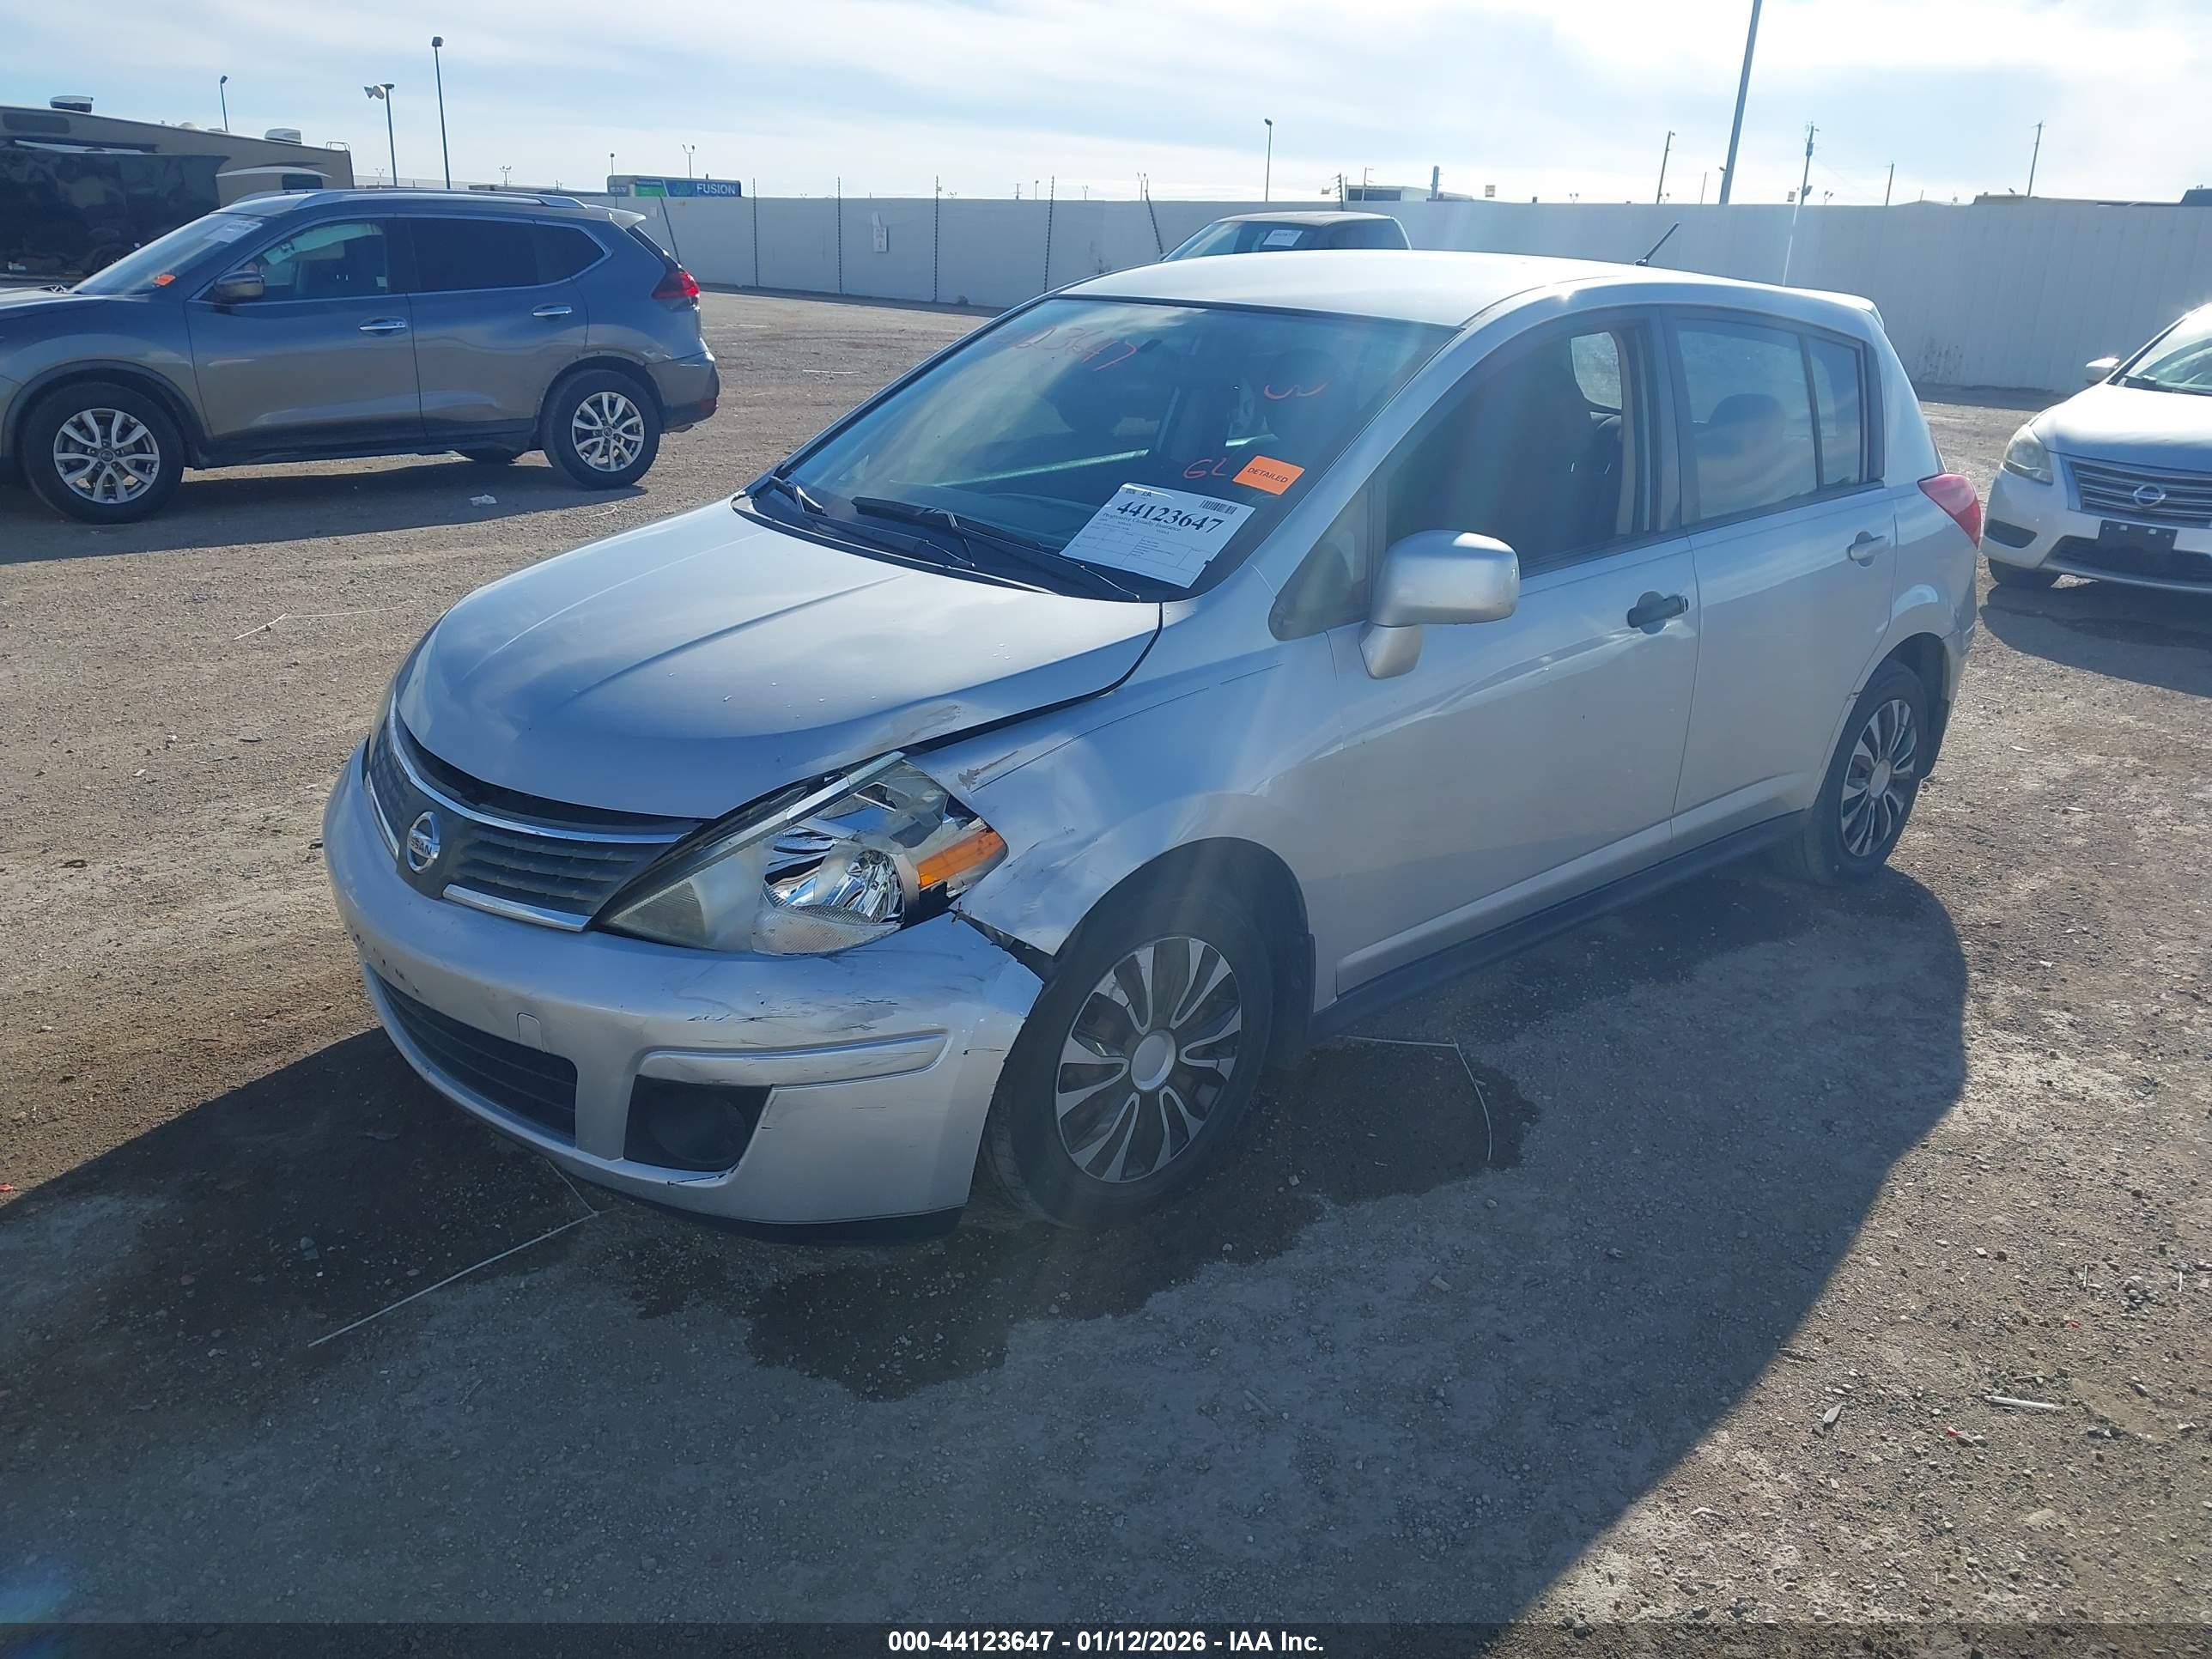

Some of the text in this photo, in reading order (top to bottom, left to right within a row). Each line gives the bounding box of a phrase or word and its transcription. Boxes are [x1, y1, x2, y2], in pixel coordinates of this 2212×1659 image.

[696, 183, 737, 195] FUSION
[1247, 467, 1288, 483] DETAILED
[1117, 501, 1224, 533] 44123647
